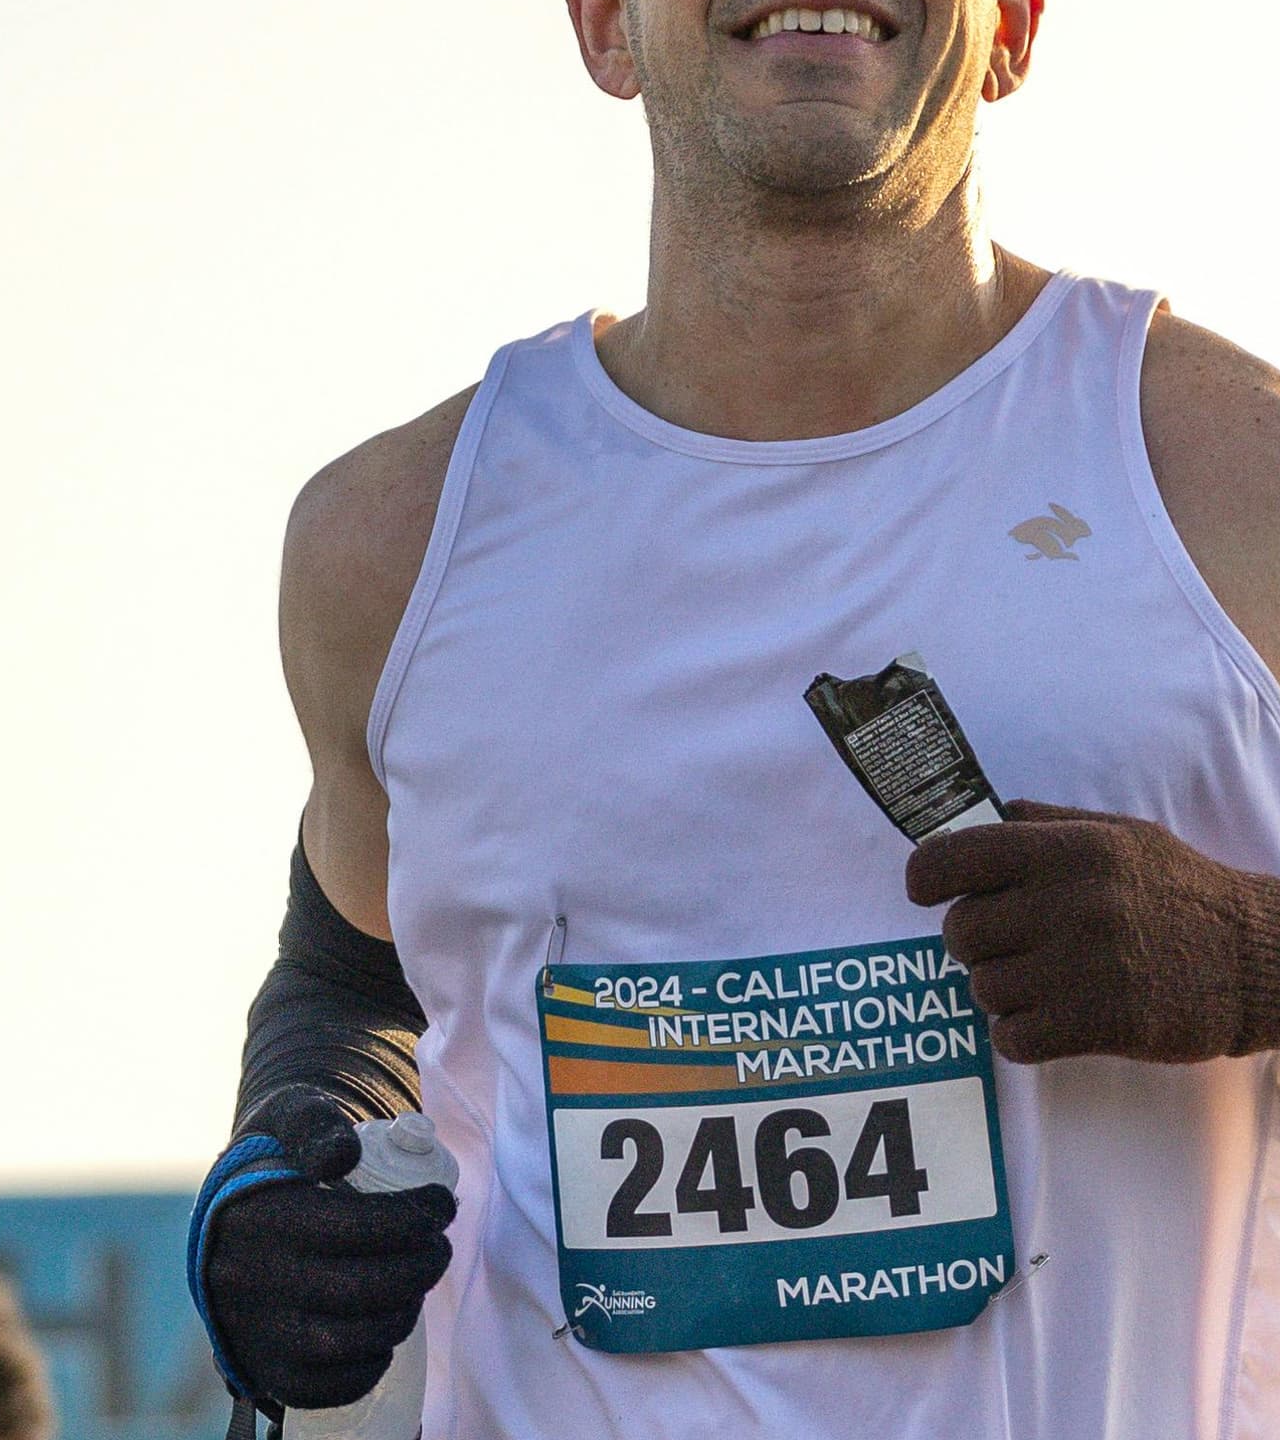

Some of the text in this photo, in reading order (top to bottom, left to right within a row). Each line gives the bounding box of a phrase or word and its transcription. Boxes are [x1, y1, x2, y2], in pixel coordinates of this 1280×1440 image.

[594, 975, 683, 1009] 2024
[715, 948, 970, 1004] CALIFORNIA
[648, 986, 973, 1047] INTERNATIONAL
[735, 1025, 977, 1083] MARATHON
[600, 1098, 929, 1239] 2464
[776, 1255, 1006, 1308] MARATHON
